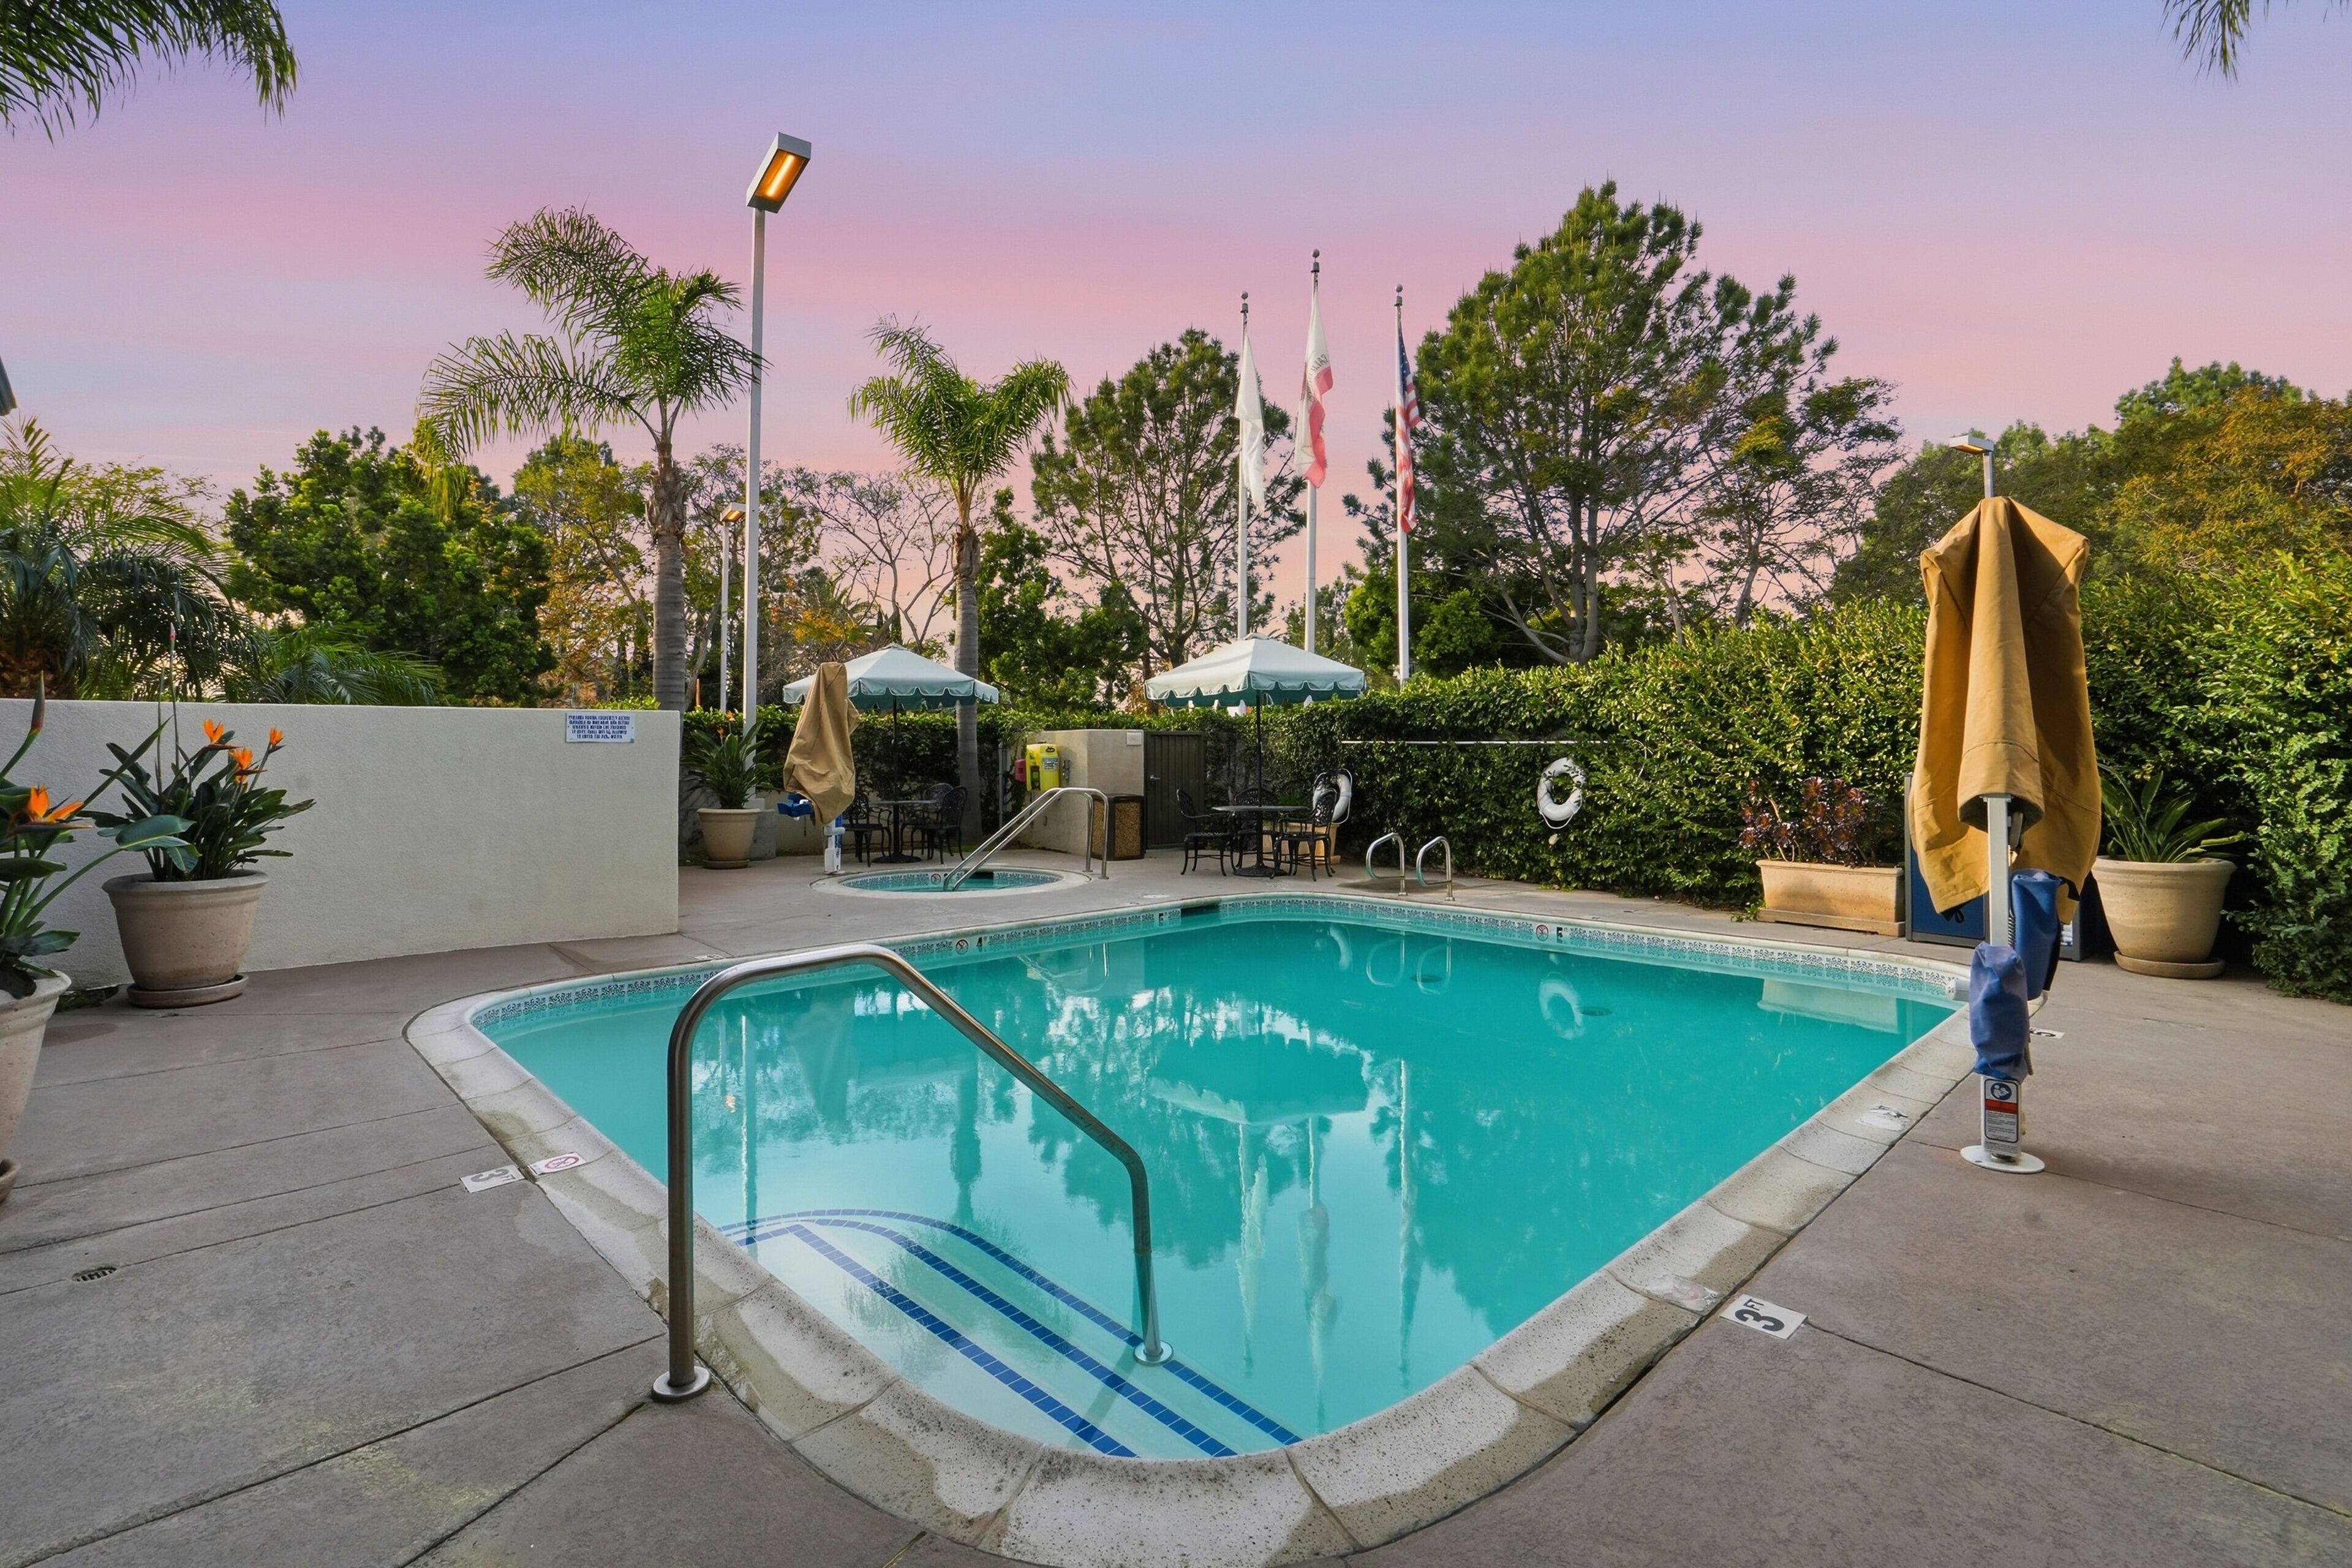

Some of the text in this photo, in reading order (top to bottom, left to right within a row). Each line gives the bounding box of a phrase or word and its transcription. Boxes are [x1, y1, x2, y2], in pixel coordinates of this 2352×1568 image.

[470, 1169, 510, 1182] 3
[1735, 1298, 1785, 1332] 3 FT
